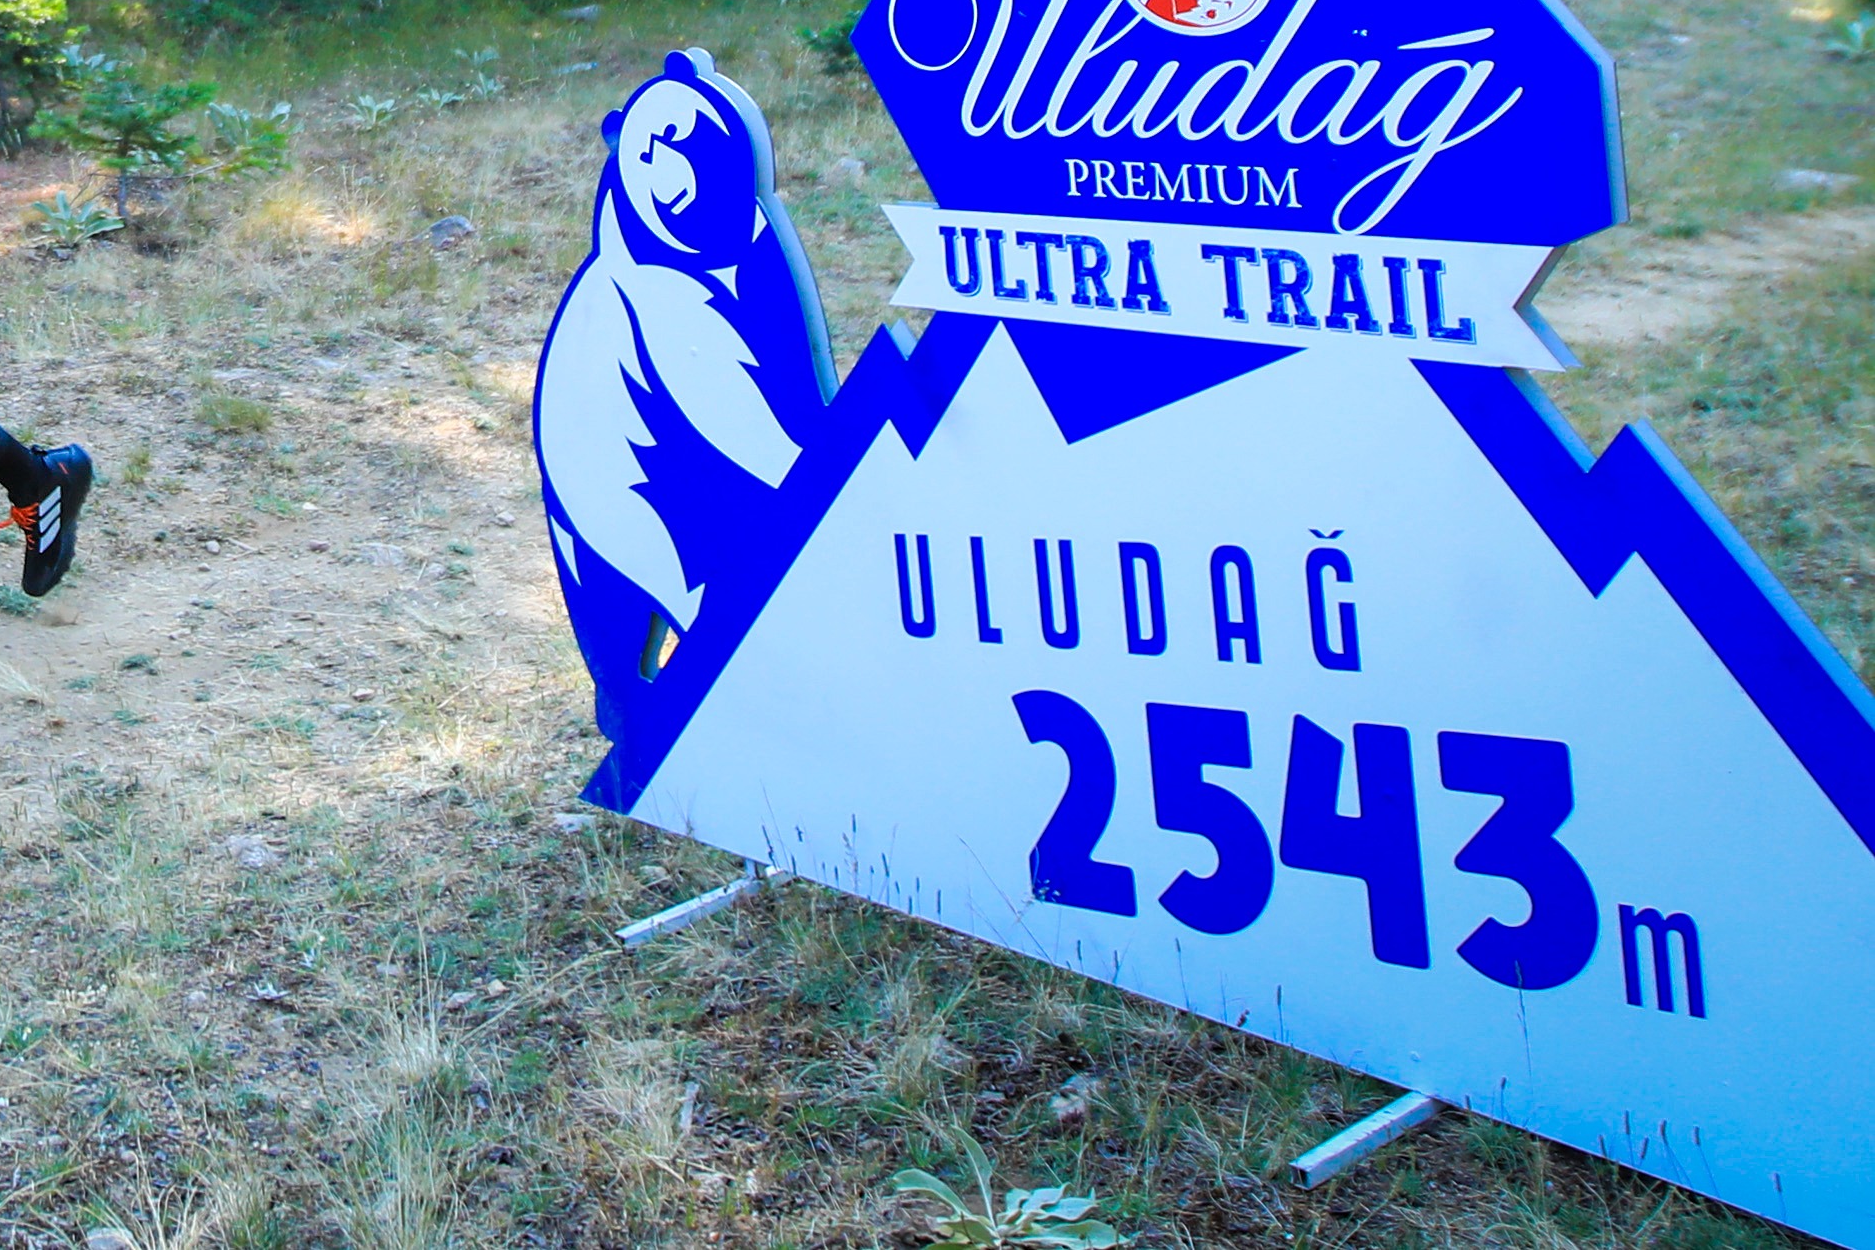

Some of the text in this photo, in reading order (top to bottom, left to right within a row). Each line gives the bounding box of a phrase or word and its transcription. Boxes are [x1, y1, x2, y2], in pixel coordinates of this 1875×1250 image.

[1063, 157, 1304, 209] PREMIUM
[937, 224, 1477, 345] ULTRA TRAIL
[893, 528, 1362, 673] ULUDAĞ
[1010, 688, 1708, 1020] 2543 m
